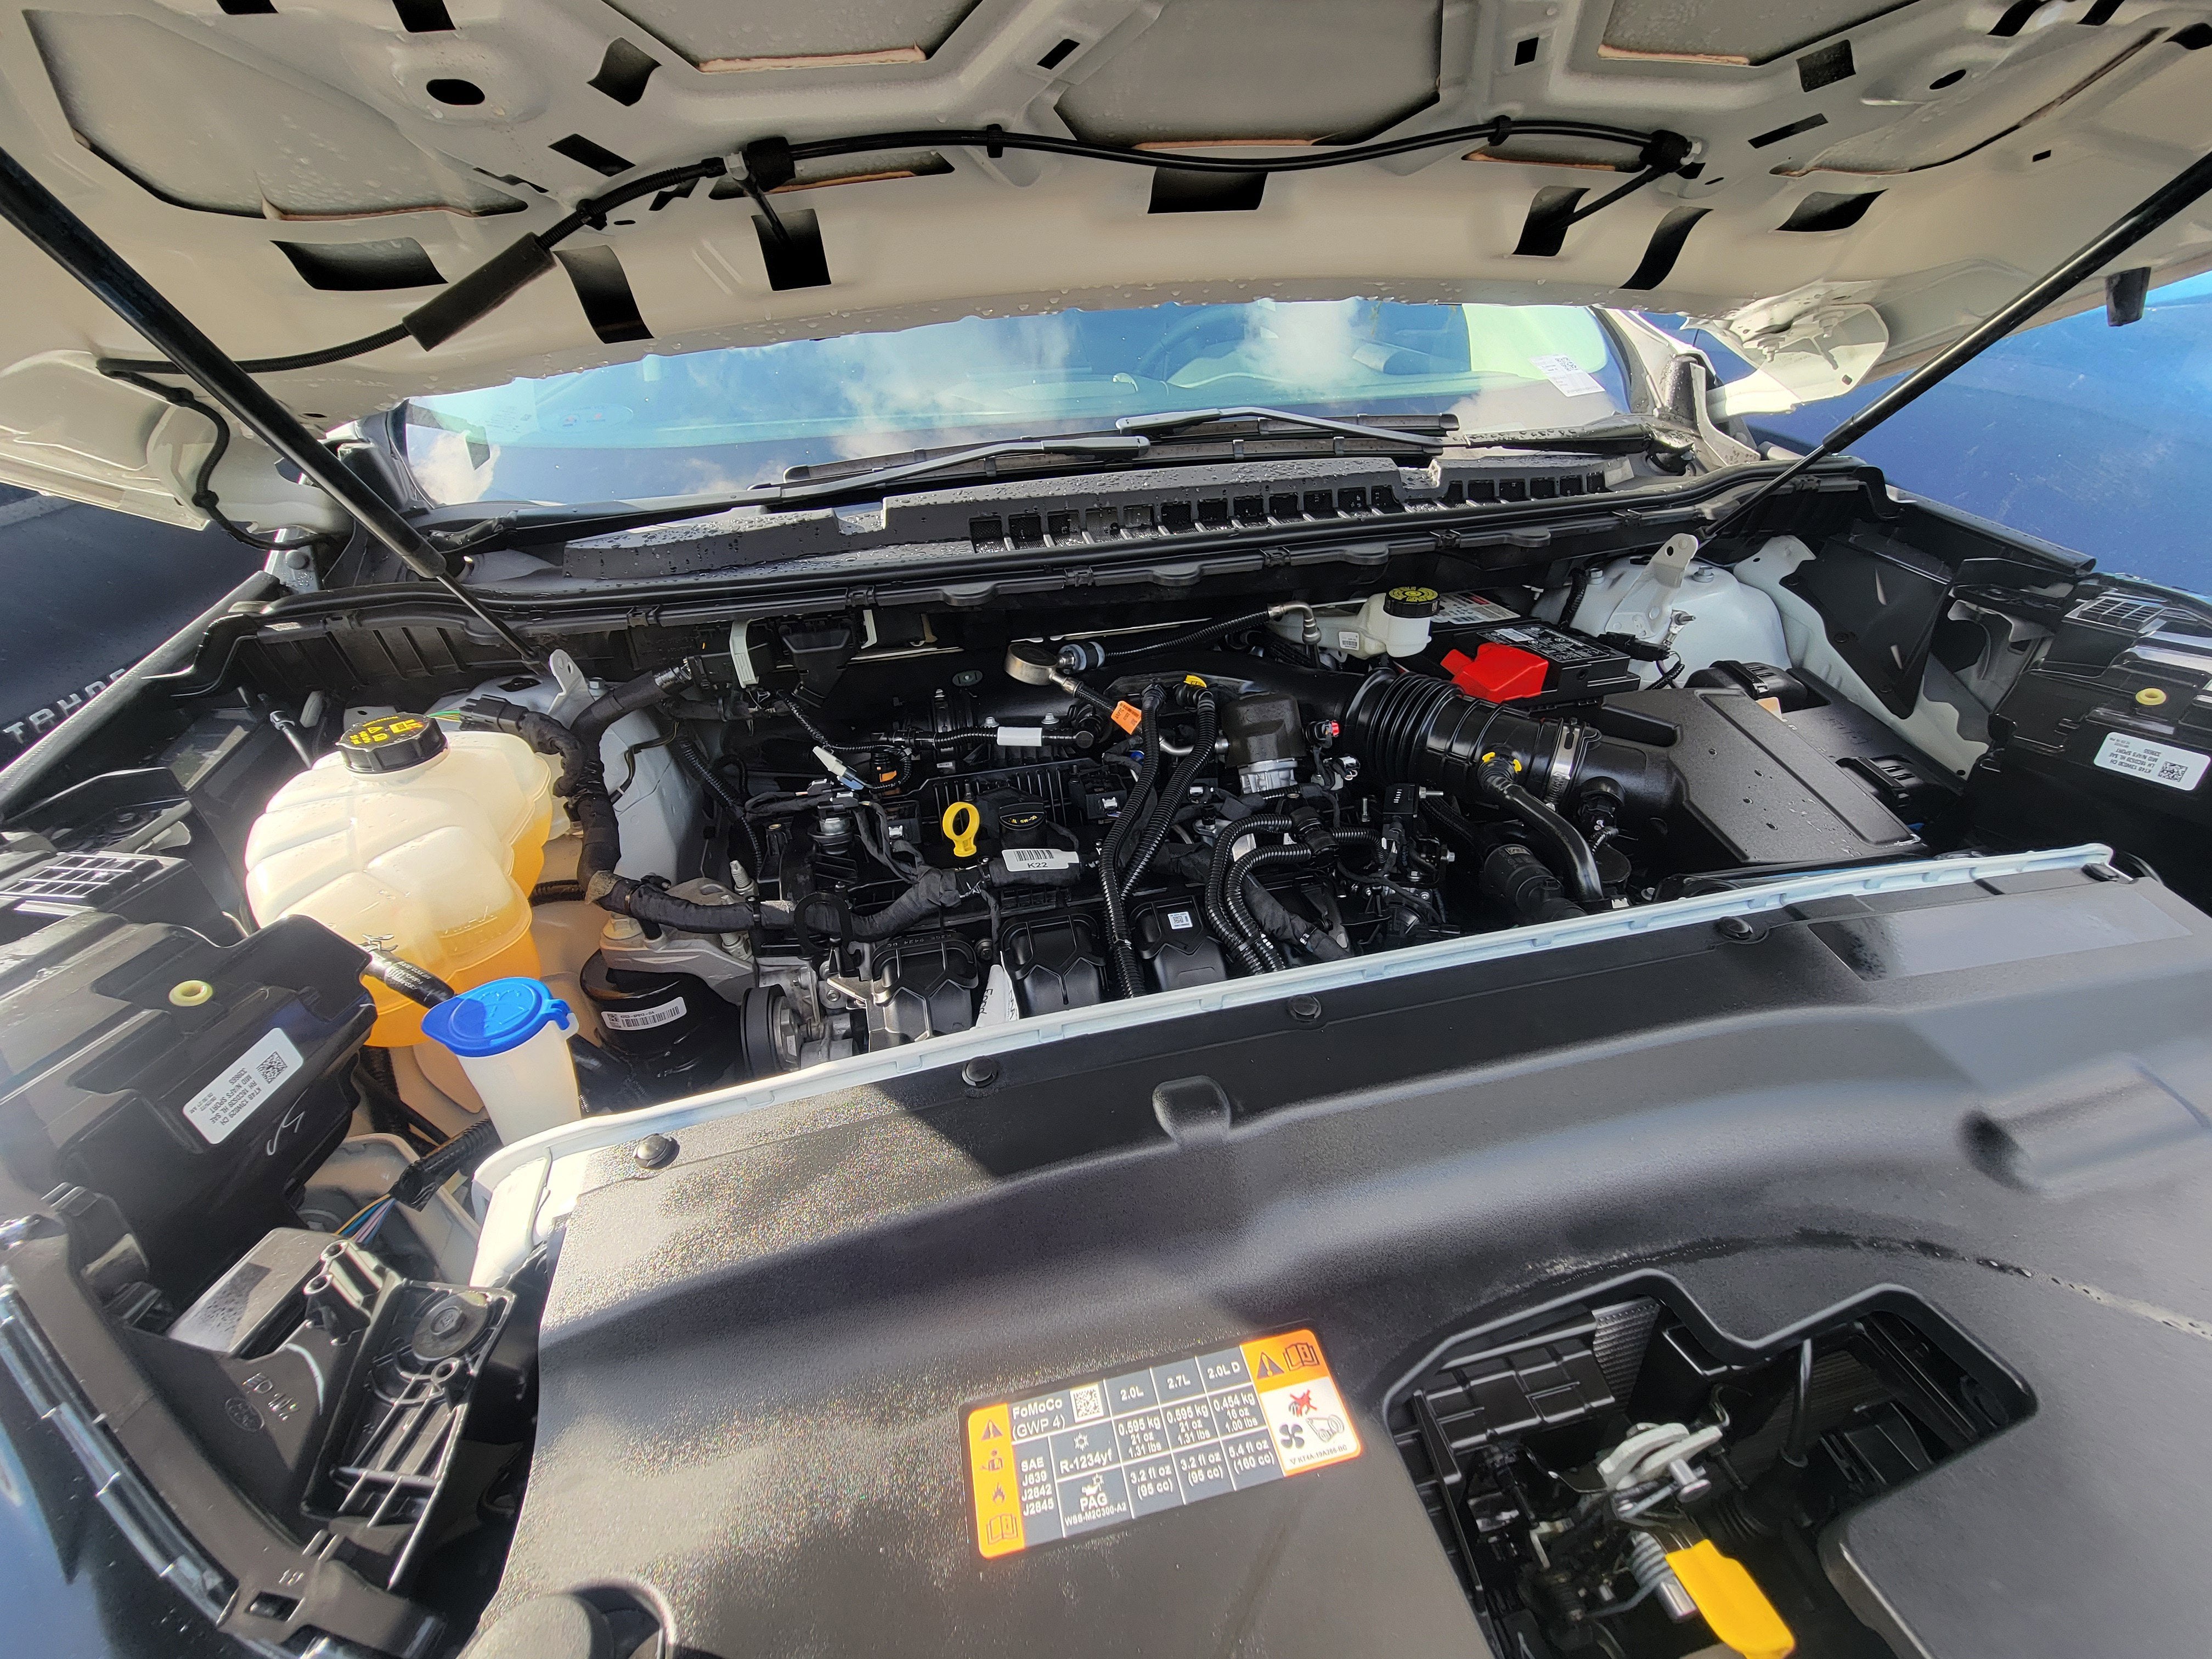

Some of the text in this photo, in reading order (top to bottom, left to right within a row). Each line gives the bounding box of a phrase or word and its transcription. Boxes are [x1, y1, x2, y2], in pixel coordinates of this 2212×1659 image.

[241, 1074, 253, 1085] MID
[249, 1080, 258, 1089] RH
[247, 1087, 262, 1101] KT4B
[209, 1096, 227, 1114] SPORT
[219, 1105, 229, 1114] HL
[229, 1098, 249, 1119] 13W029
[209, 1111, 222, 1125] SAE
[1207, 1361, 1240, 1380] 2.0L D
[1167, 1374, 1191, 1390] 2.7L
[1120, 1386, 1144, 1401] 2.0L
[1213, 1392, 1255, 1412] 0.454 kg
[1012, 1398, 1063, 1420] FoMoCo
[1166, 1404, 1209, 1424] 0.595 kg
[1227, 1407, 1250, 1420] 16 oz
[1012, 1414, 1065, 1441] (GWP 4)
[1118, 1416, 1161, 1436] 0.595 kg
[1179, 1419, 1203, 1433] 21 oz
[1225, 1417, 1258, 1433] 1.00 lbs
[1130, 1432, 1154, 1446] 21 oz
[1177, 1429, 1211, 1445] 1.31 lbs
[1128, 1442, 1162, 1458] 1.31 lbs
[1228, 1439, 1269, 1458] 5.4 fl oz
[1021, 1456, 1045, 1472] SAE
[1059, 1448, 1113, 1474] R-1234yf
[1180, 1452, 1222, 1471] 3.2 fl oz
[1233, 1451, 1274, 1475] (160 cc)
[1022, 1470, 1047, 1487] J639
[1130, 1465, 1172, 1484] 3.2 fl oz
[1188, 1465, 1223, 1487] (95 cc)
[1021, 1483, 1052, 1502] J2842
[1136, 1477, 1173, 1500] (95 cc)
[1023, 1497, 1054, 1517] J2845
[1080, 1492, 1108, 1512] PAG
